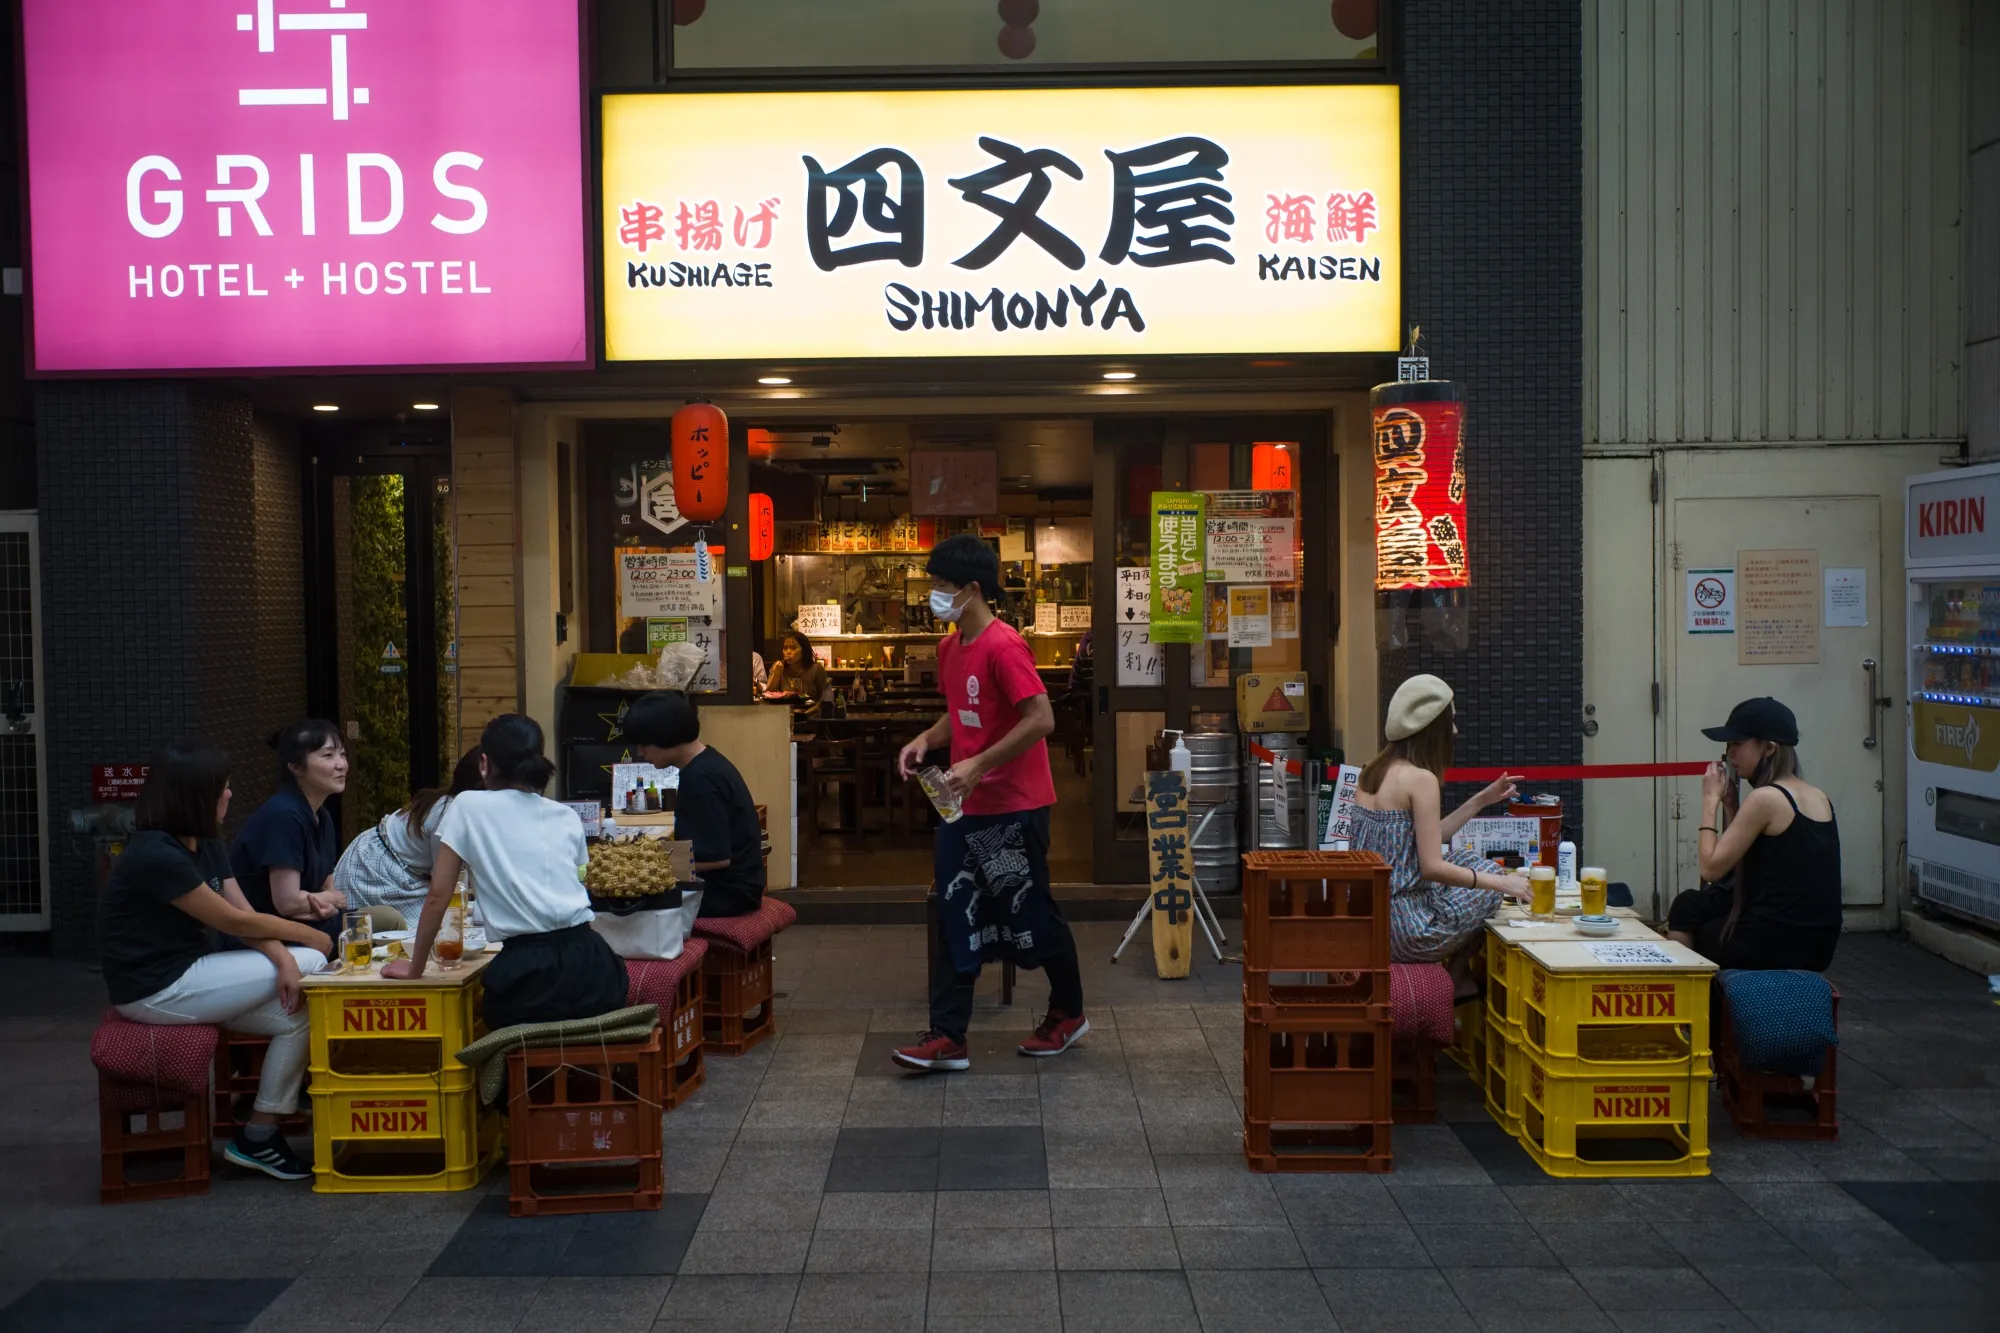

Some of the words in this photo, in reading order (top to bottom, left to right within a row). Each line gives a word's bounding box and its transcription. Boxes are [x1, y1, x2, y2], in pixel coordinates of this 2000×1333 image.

[126, 152, 488, 239] GRIDS
[802, 136, 1235, 272] 四文屋
[620, 197, 781, 252] 串揚げ
[1266, 192, 1376, 243] 海鮮
[128, 264, 268, 298] HOTEL
[284, 269, 304, 289] +
[323, 261, 491, 295] HOSTEL
[627, 261, 773, 288] KUSHIAGE
[1258, 254, 1380, 281] KAISEN
[885, 278, 1145, 332] SHIMONYA
[690, 426, 709, 503] ホッピー
[760, 506, 770, 550] ホッピー
[1204, 520, 1248, 533] 営業時間
[1918, 496, 1985, 537] KIRIN
[1158, 516, 1179, 589] 使えます
[1181, 516, 1197, 562] 当店で
[625, 555, 668, 569] 営業時間
[1935, 724, 1965, 748] FIRE
[1147, 772, 1192, 925] 営業中
[343, 1007, 428, 1032] KIRIN
[1592, 993, 1676, 1018] KIRIN
[351, 1110, 428, 1132] KIRIN
[1593, 1097, 1671, 1118] KIRIN
